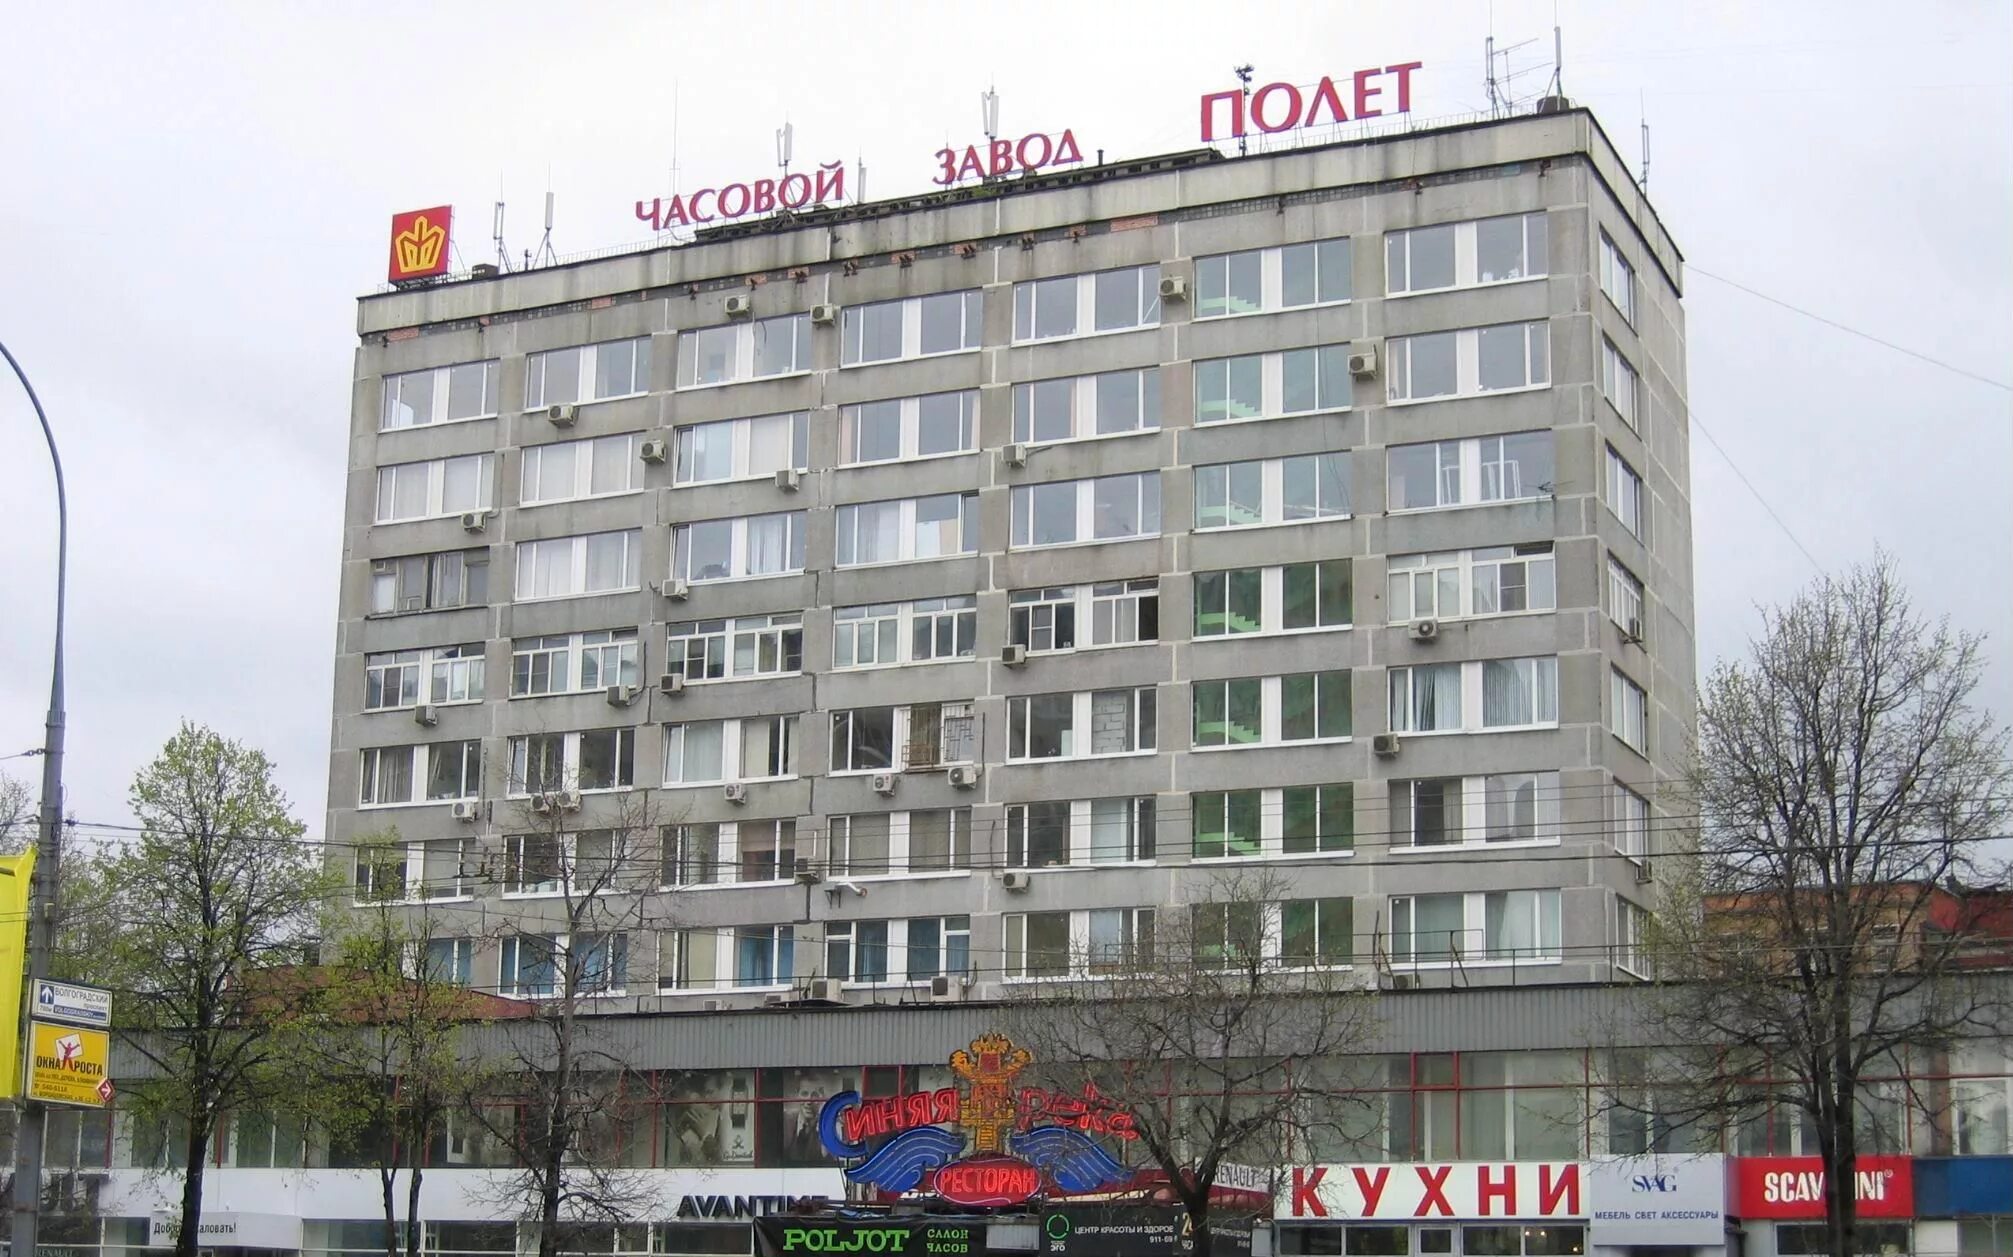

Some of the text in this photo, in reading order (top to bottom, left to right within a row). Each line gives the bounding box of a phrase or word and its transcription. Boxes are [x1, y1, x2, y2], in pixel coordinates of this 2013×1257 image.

[635, 61, 1422, 231] ЧАСОВОЙ ЗАВОД ПОЛЕТ
[36, 1055, 103, 1076] ОКНА РОСТА
[818, 1087, 960, 1158] Синяя
[940, 1166, 1037, 1194] РЕСТОРАН
[1632, 1174, 1678, 1193] SVAG
[1291, 1164, 1580, 1218] КУХНИ
[1594, 1210, 1719, 1220] МЕБЕЛЬ СВЕТ АКСЕССУАРЫ
[783, 1228, 910, 1252] POLJOT
[927, 1228, 969, 1239] САЛОН
[1074, 1226, 1099, 1235] ЦЕНТР
[1100, 1226, 1136, 1234] КРАСОТЫ
[1137, 1226, 1143, 1234] И
[926, 1243, 969, 1253] ЧАСОВ
